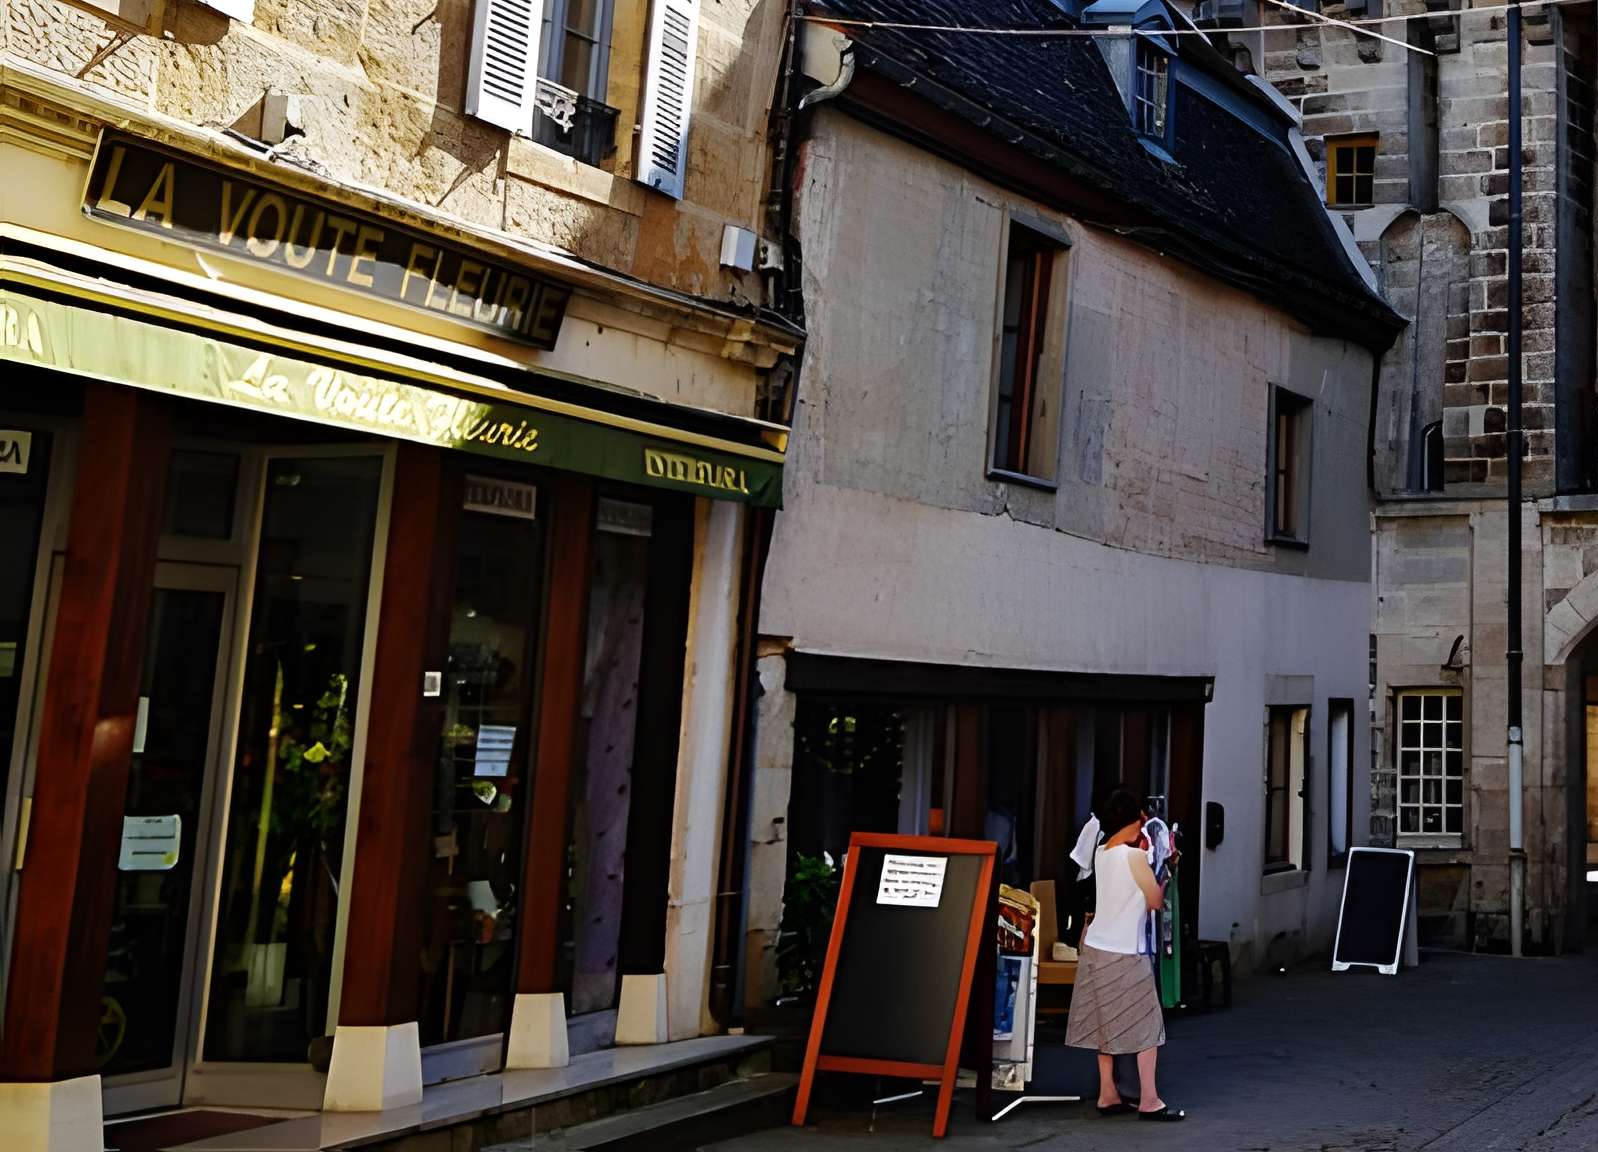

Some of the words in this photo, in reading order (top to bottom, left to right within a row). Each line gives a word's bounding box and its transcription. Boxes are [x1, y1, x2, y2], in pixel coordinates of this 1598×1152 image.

[96, 147, 174, 228] LA
[218, 180, 385, 288] VOUTE
[400, 242, 567, 338] FLEURIE
